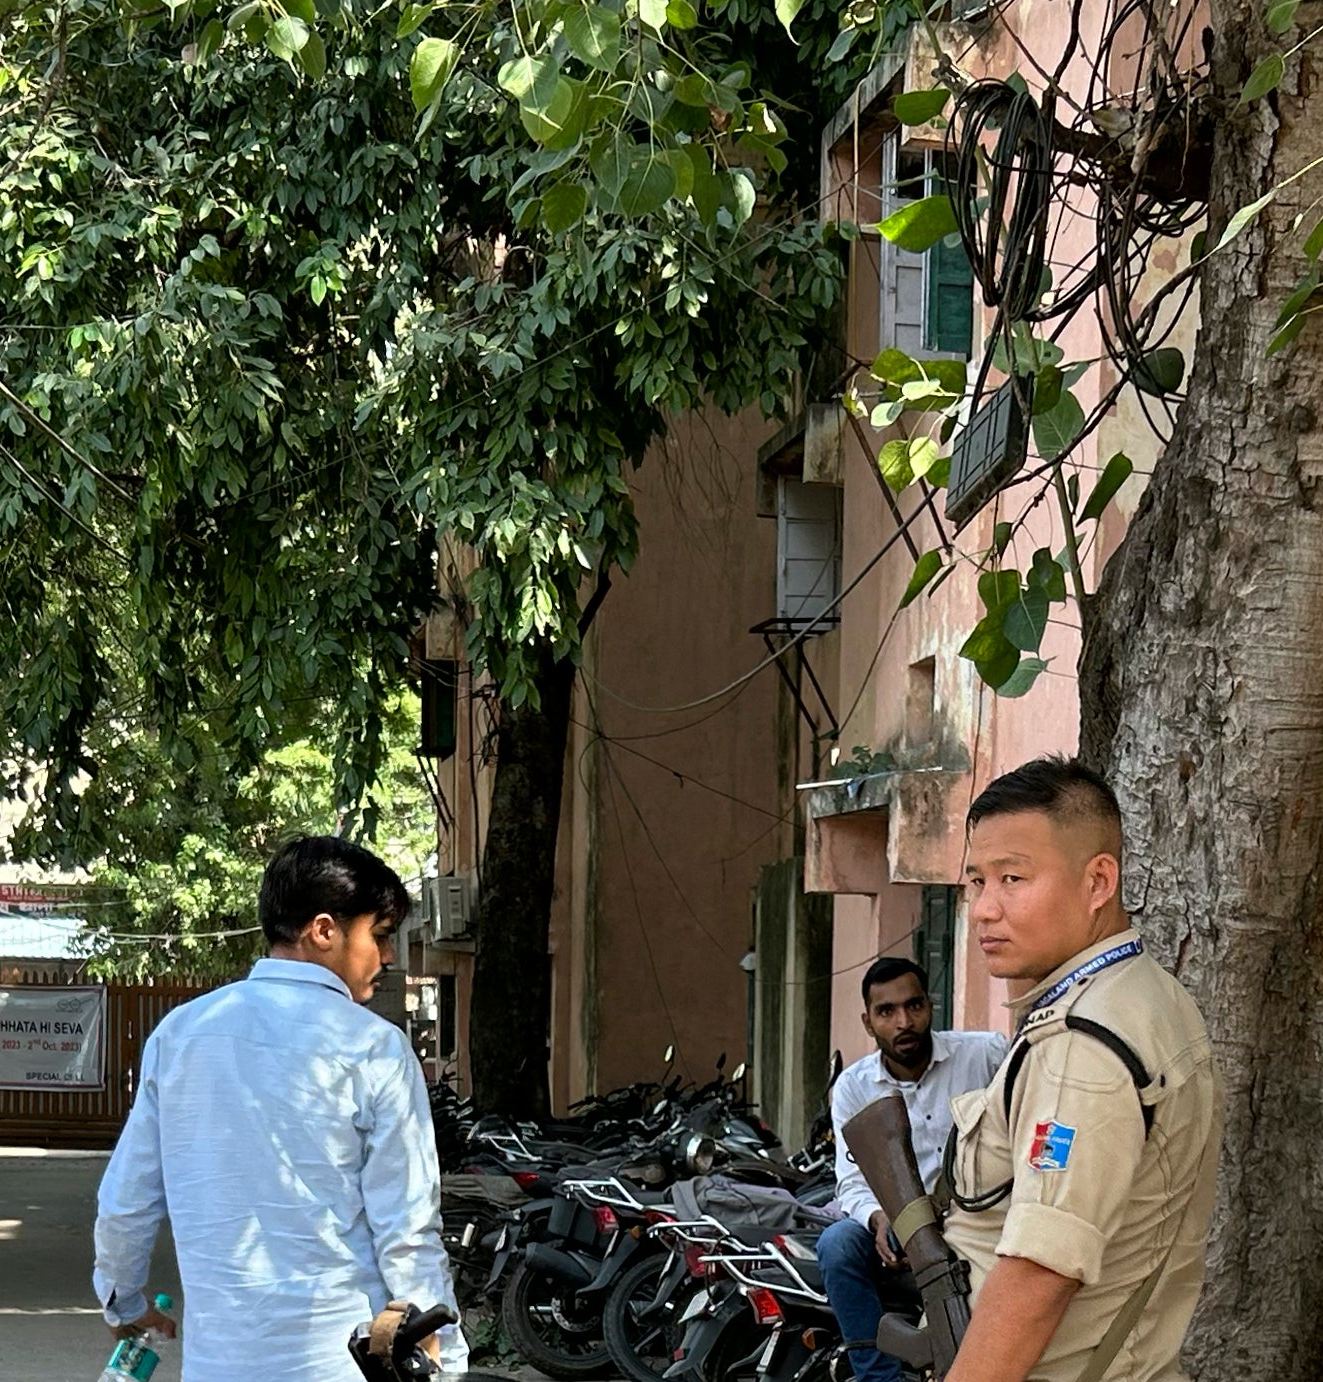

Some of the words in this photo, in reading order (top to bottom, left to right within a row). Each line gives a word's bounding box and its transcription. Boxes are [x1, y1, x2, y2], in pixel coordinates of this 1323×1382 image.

[1074, 957, 1106, 980] ARMED
[1106, 945, 1132, 962] POLICE
[1024, 1010, 1055, 1026] NAP
[40, 1021, 51, 1034] HI
[54, 1022, 83, 1035] SEVA
[26, 1072, 61, 1081] SPECIAL
